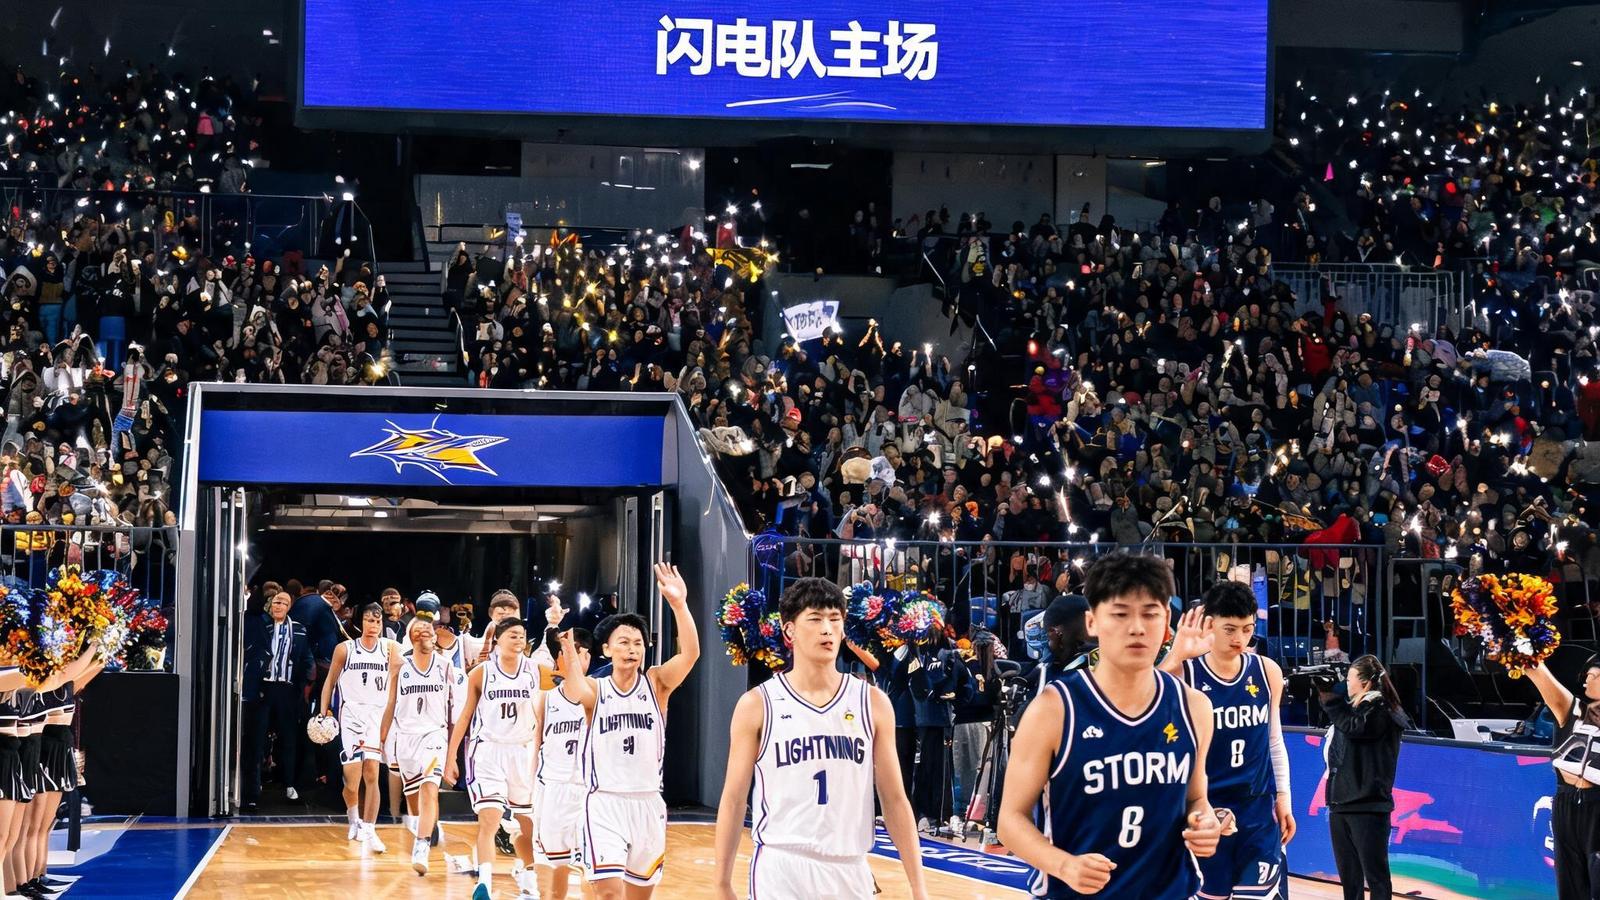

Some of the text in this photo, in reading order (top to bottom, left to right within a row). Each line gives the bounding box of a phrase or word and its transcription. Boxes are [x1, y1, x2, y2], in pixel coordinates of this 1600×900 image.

[656, 14, 938, 81] 闪电队主场
[1213, 704, 1269, 730] TORM
[775, 735, 865, 768] LIGHTNING
[1230, 739, 1246, 768] 8
[812, 770, 829, 805] 1
[1083, 751, 1190, 795] STORM
[1118, 805, 1145, 848] 8
